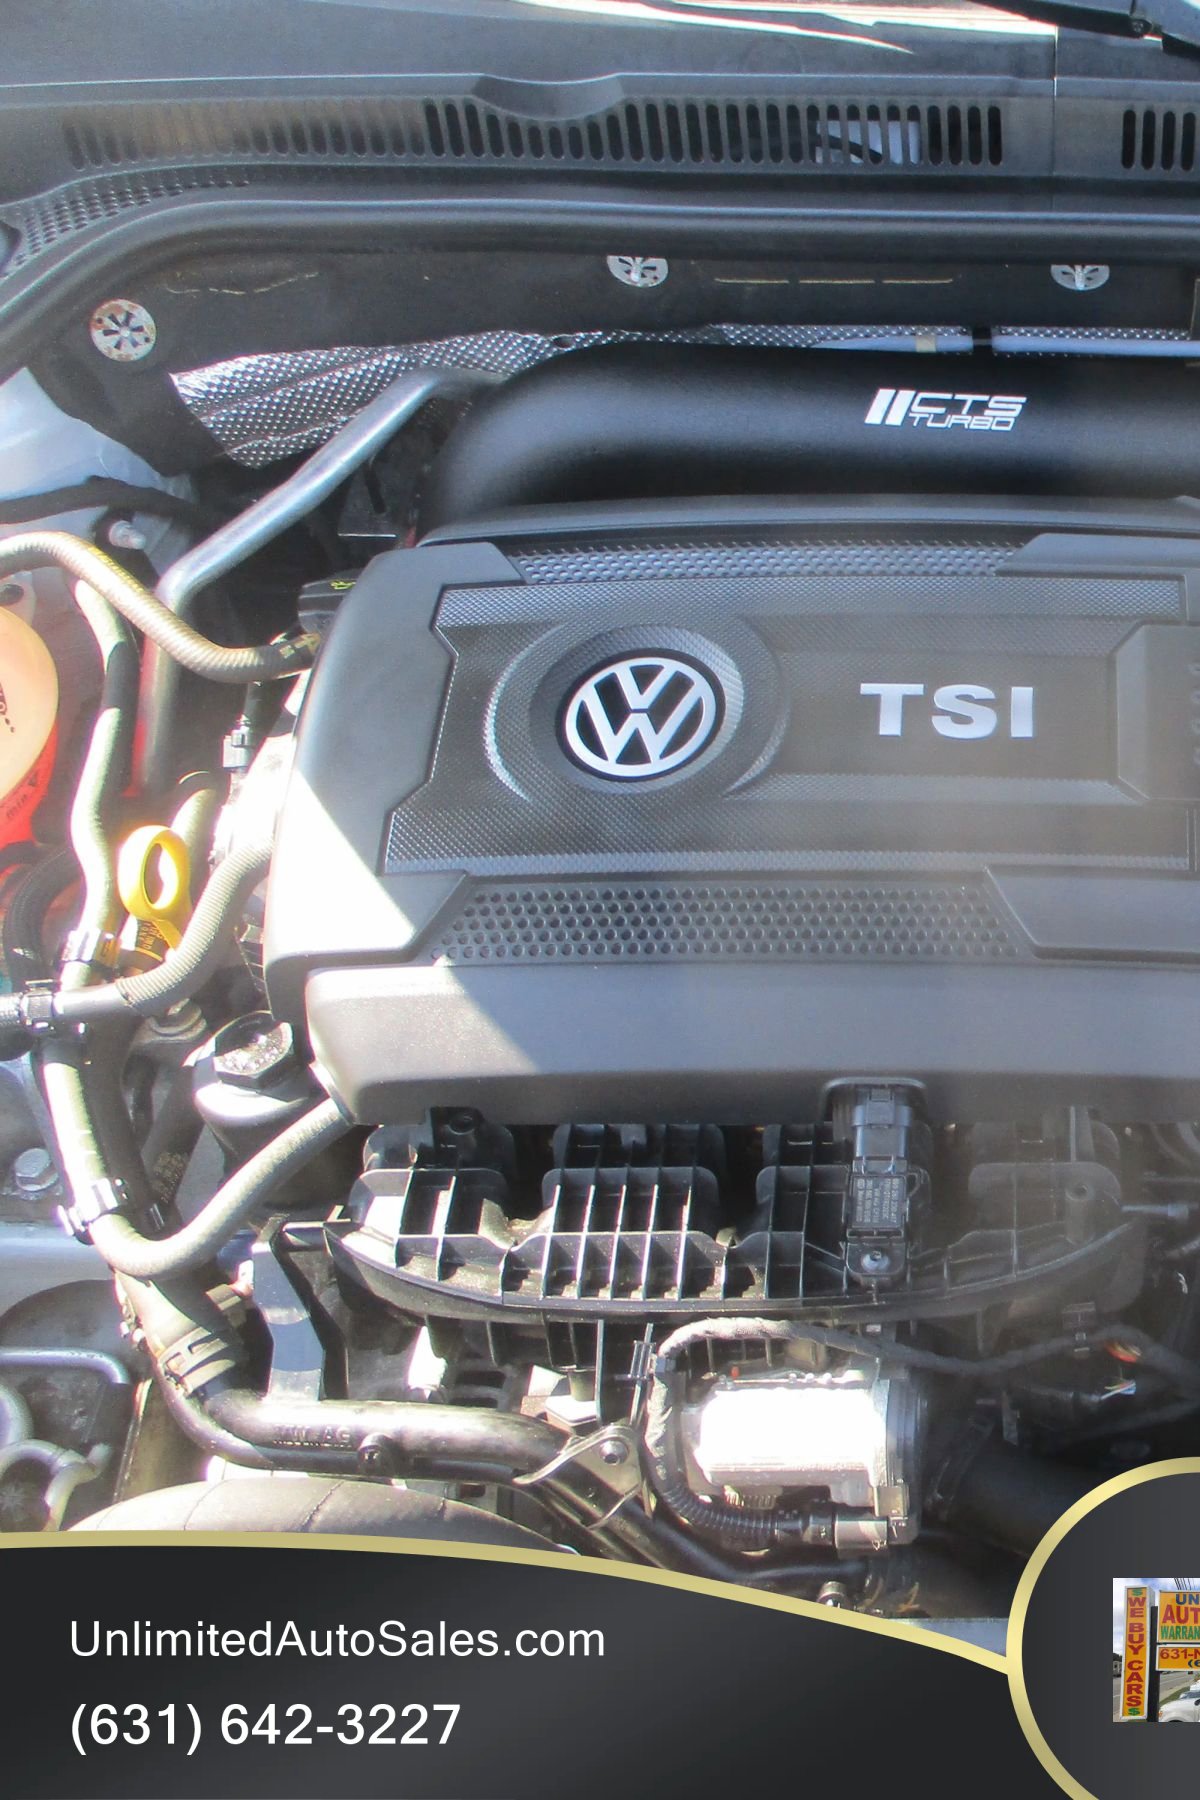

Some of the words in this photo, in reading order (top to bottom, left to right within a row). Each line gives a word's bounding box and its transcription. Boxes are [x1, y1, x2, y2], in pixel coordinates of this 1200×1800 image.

[911, 392, 1027, 417] CTS
[909, 413, 1015, 431] TURBO
[860, 683, 1034, 739] TSI
